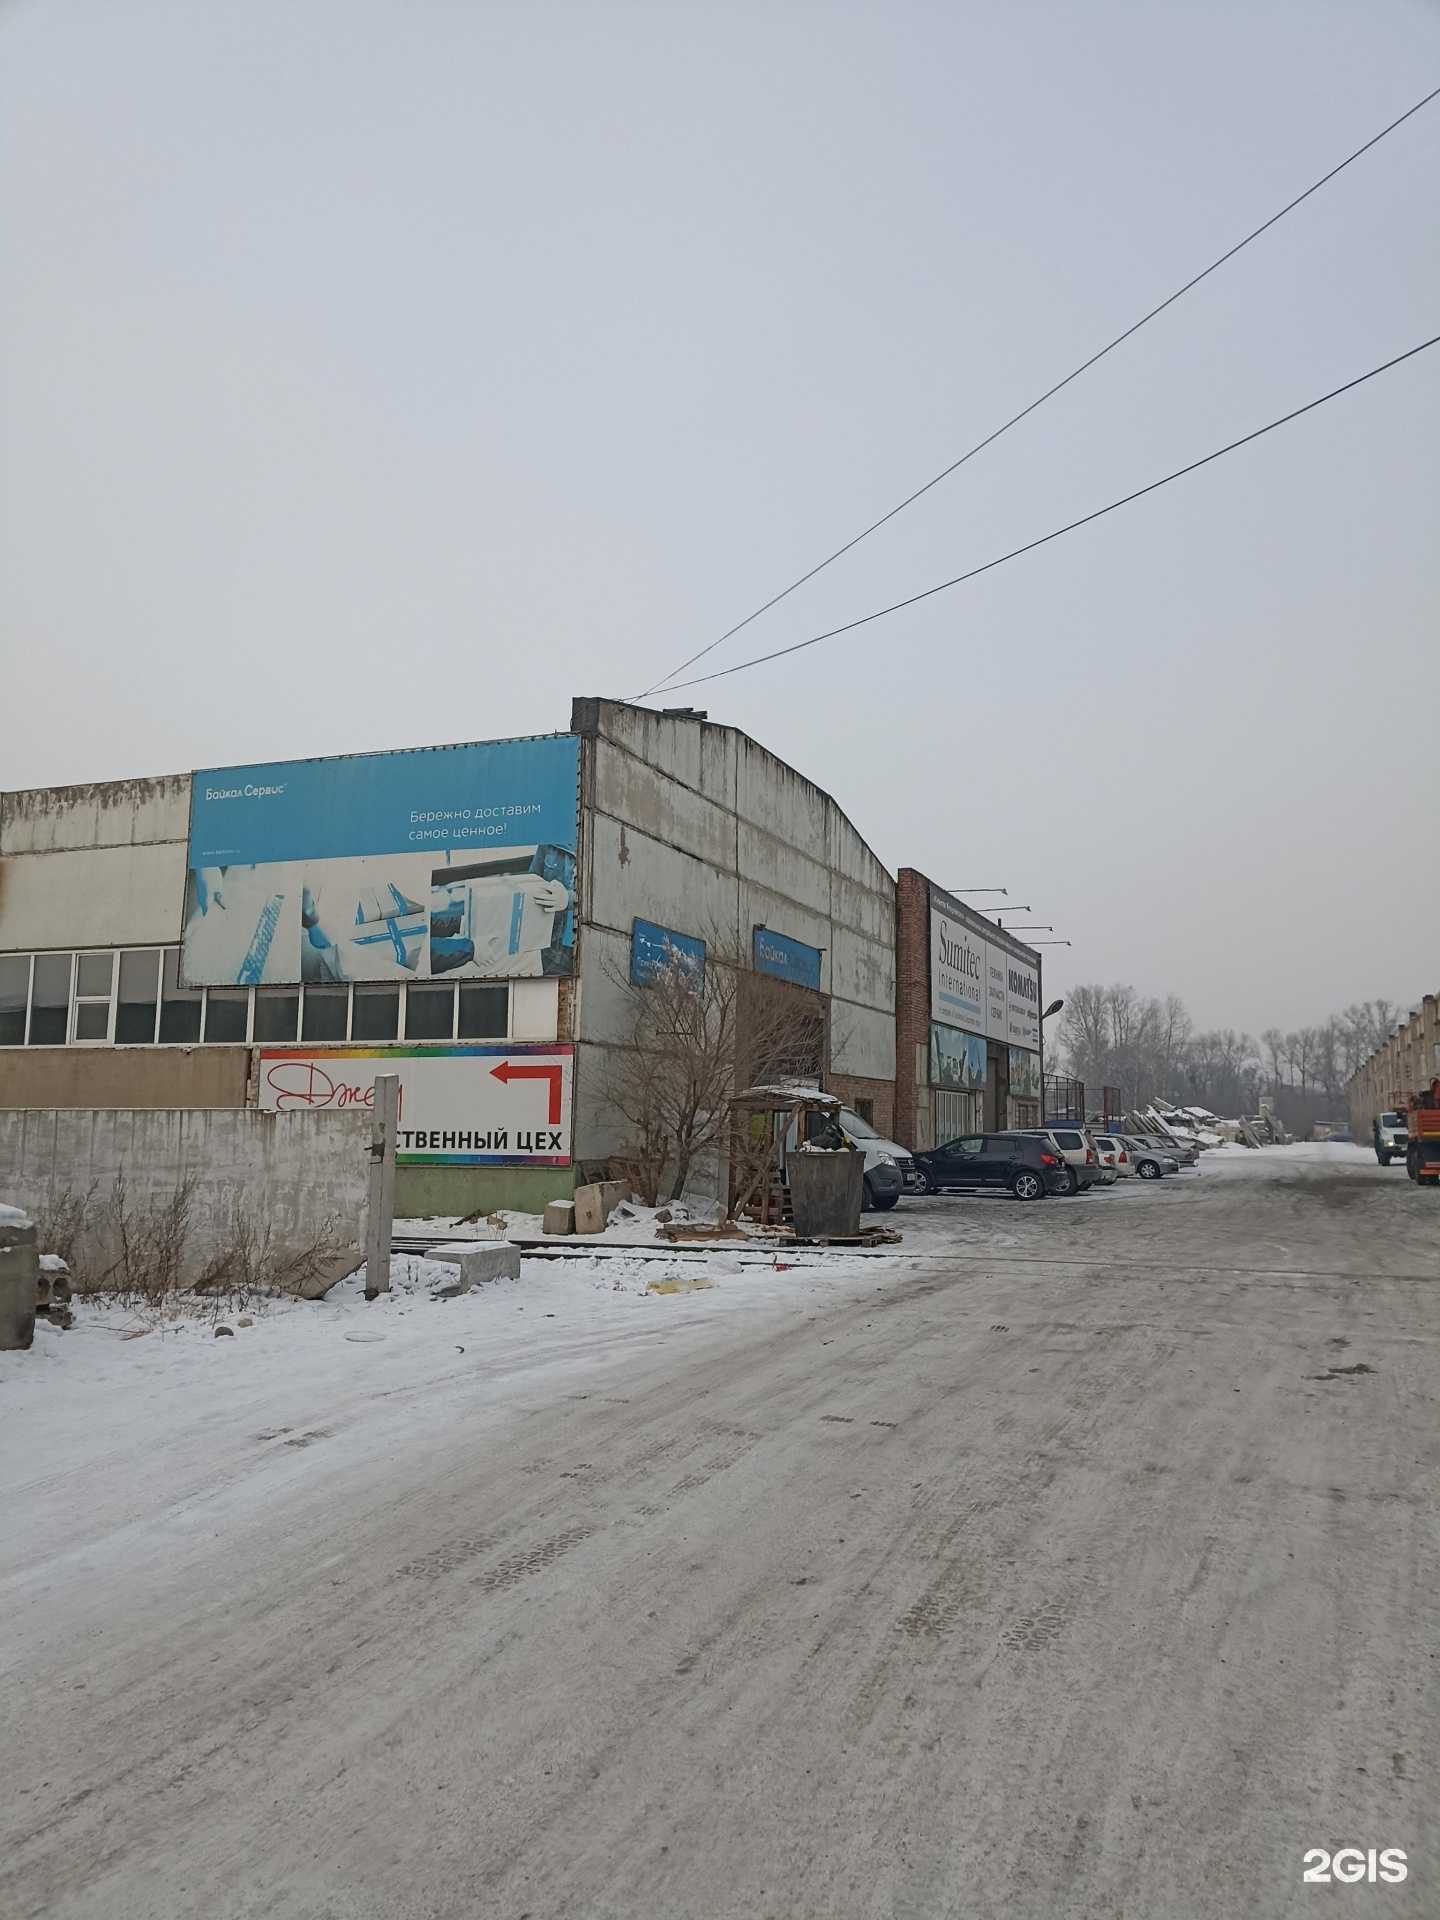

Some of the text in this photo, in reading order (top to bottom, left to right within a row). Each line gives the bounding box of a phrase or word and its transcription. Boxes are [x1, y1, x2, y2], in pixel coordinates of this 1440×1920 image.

[206, 783, 284, 801] Байкал Сервис
[410, 803, 541, 823] Бережно доставим
[408, 821, 508, 841] самое ценное!
[939, 919, 981, 980] Sumitec
[938, 967, 981, 1003] International
[1008, 969, 1037, 1003] KOMATSU
[396, 1127, 562, 1153] ТВЕННЫЙ ЦЕХ
